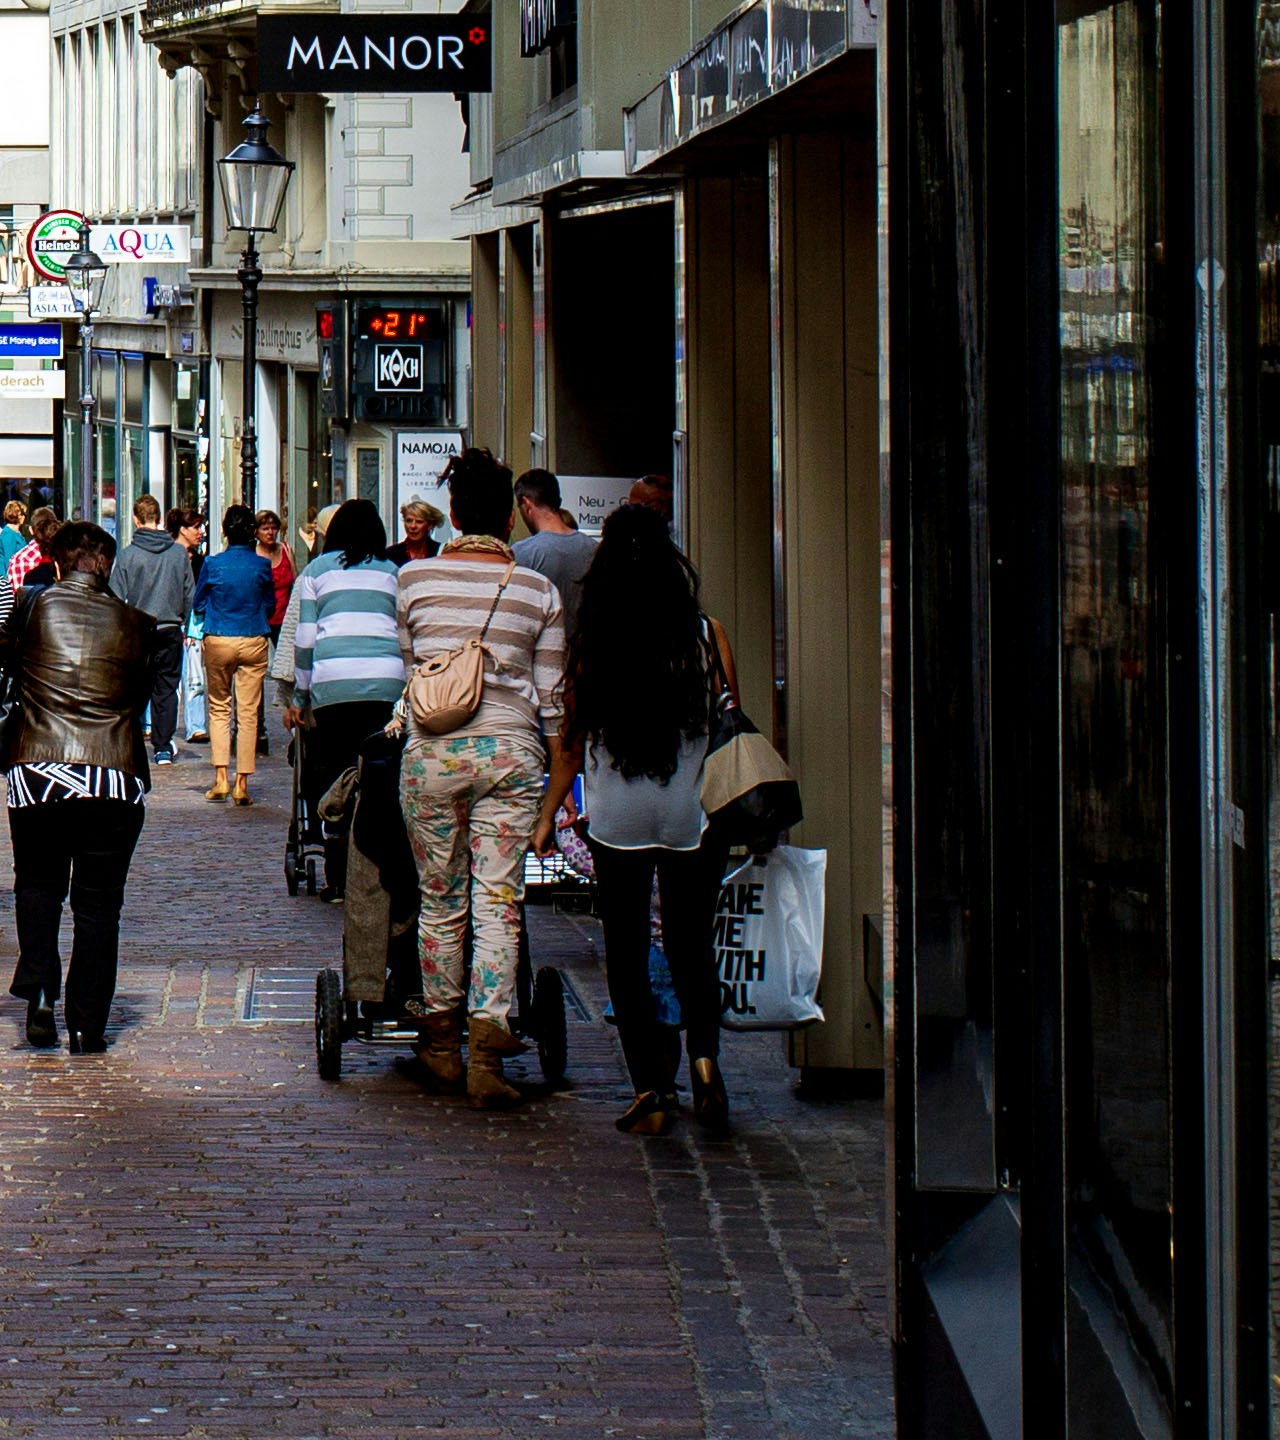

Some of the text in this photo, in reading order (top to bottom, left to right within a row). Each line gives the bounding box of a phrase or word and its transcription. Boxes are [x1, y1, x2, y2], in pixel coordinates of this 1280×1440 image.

[286, 34, 466, 71] MANOR
[38, 240, 80, 251] Heinek
[103, 229, 176, 260] AQUA
[10, 336, 37, 347] Money
[38, 336, 60, 345] Bank
[402, 442, 458, 455] NAMOJA
[578, 495, 606, 508] Neu
[720, 982, 757, 1015] OU.
